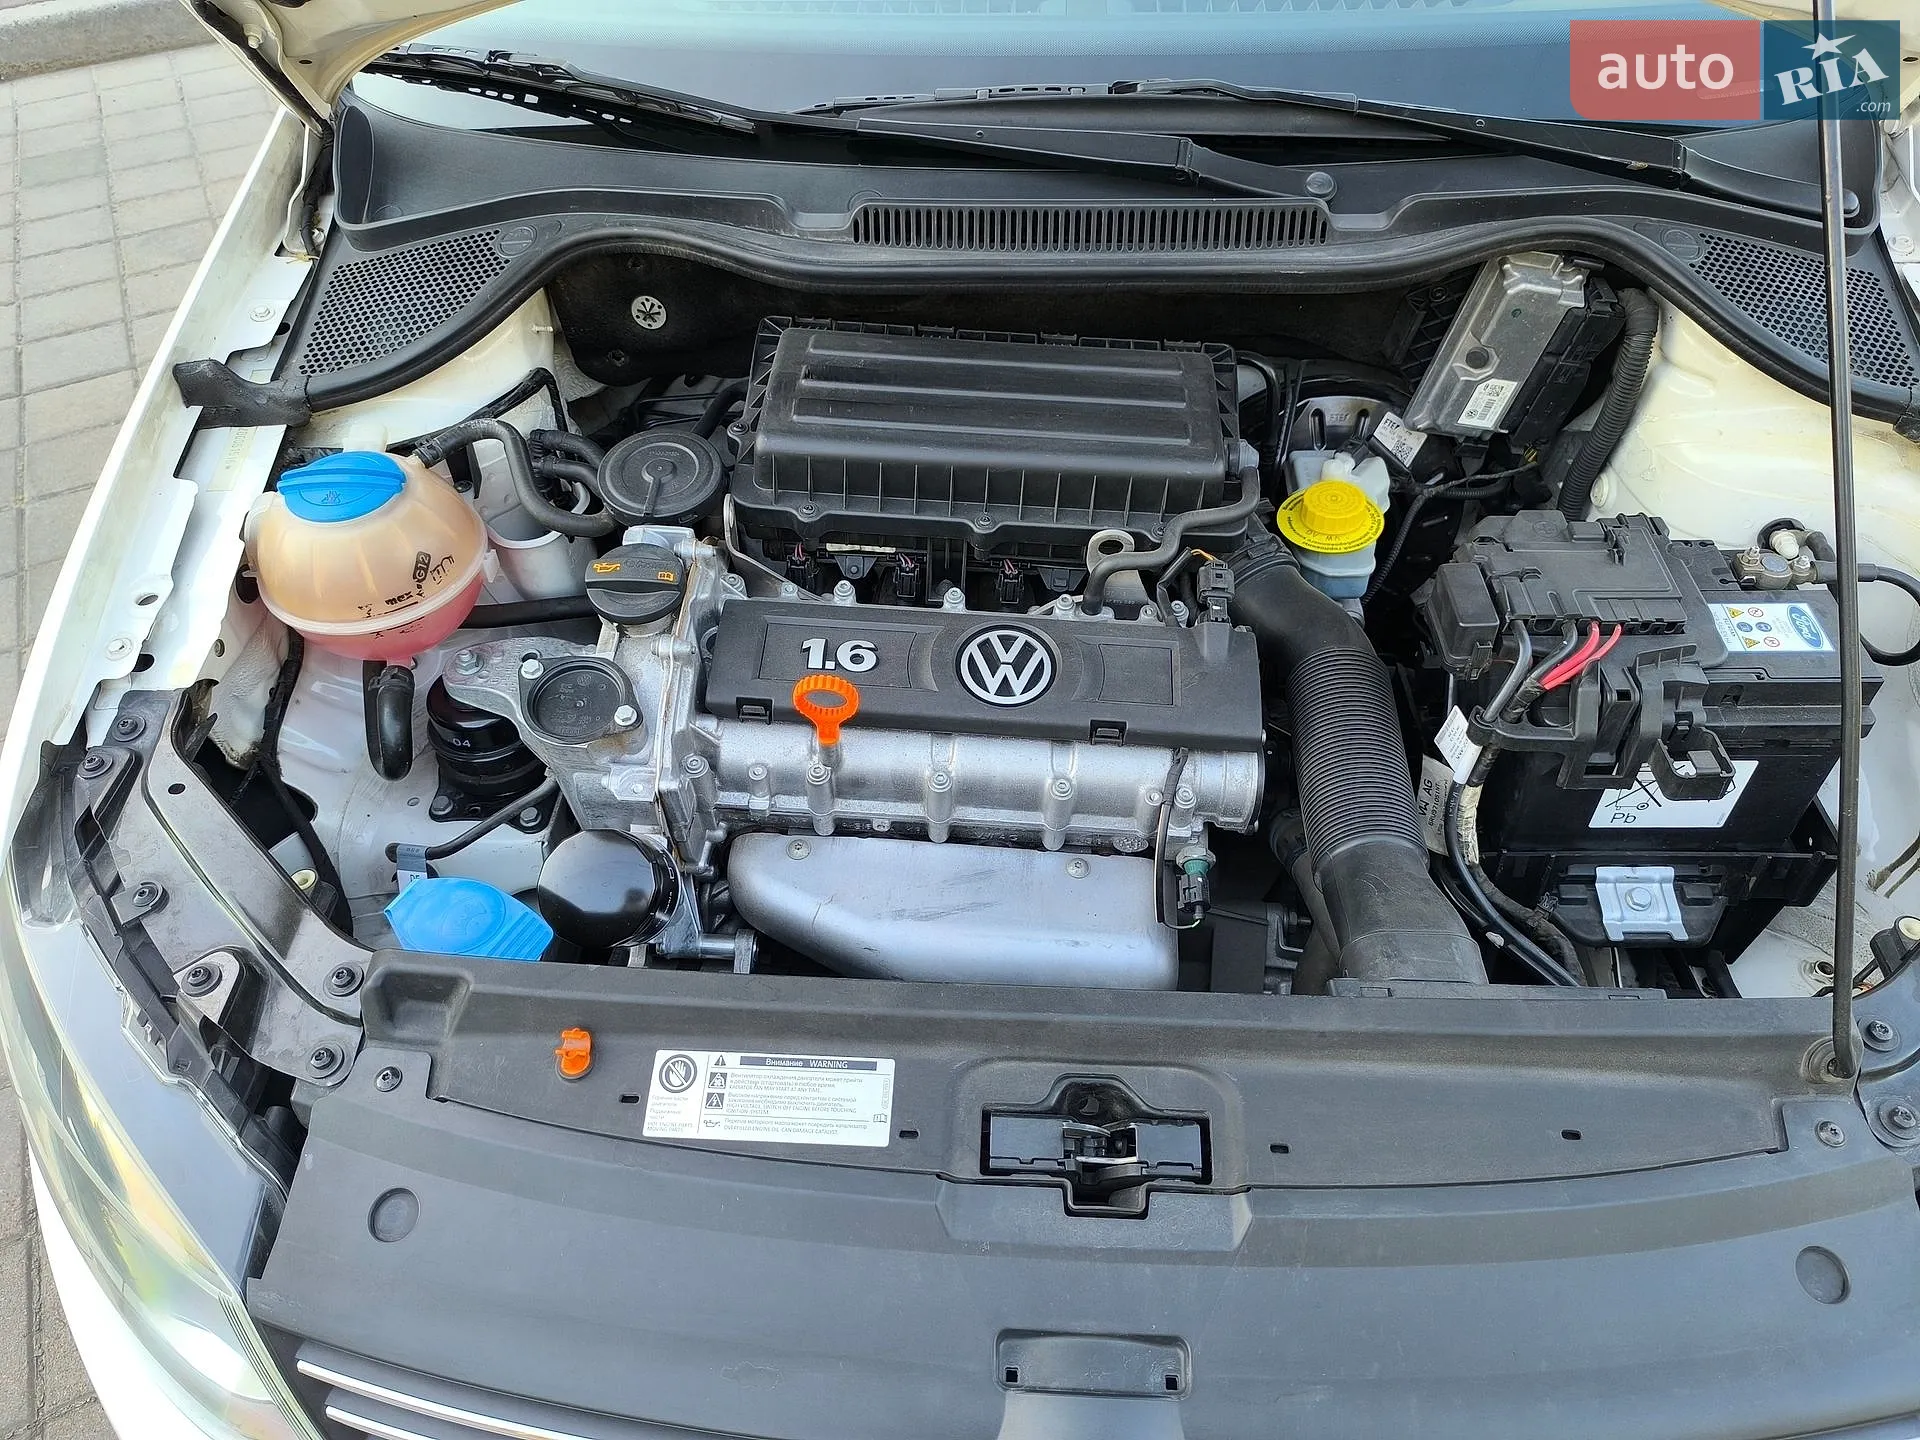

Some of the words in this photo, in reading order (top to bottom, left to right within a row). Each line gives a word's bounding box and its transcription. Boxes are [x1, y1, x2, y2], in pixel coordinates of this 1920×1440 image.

[415, 553, 429, 580] G12
[1790, 611, 1818, 642] Ford
[801, 638, 878, 673] 1.6
[1423, 778, 1433, 797] AG
[1418, 799, 1430, 817] VW
[1610, 812, 1637, 824] Pb
[765, 1057, 804, 1068] Внимание
[809, 1059, 849, 1070] WARNING
